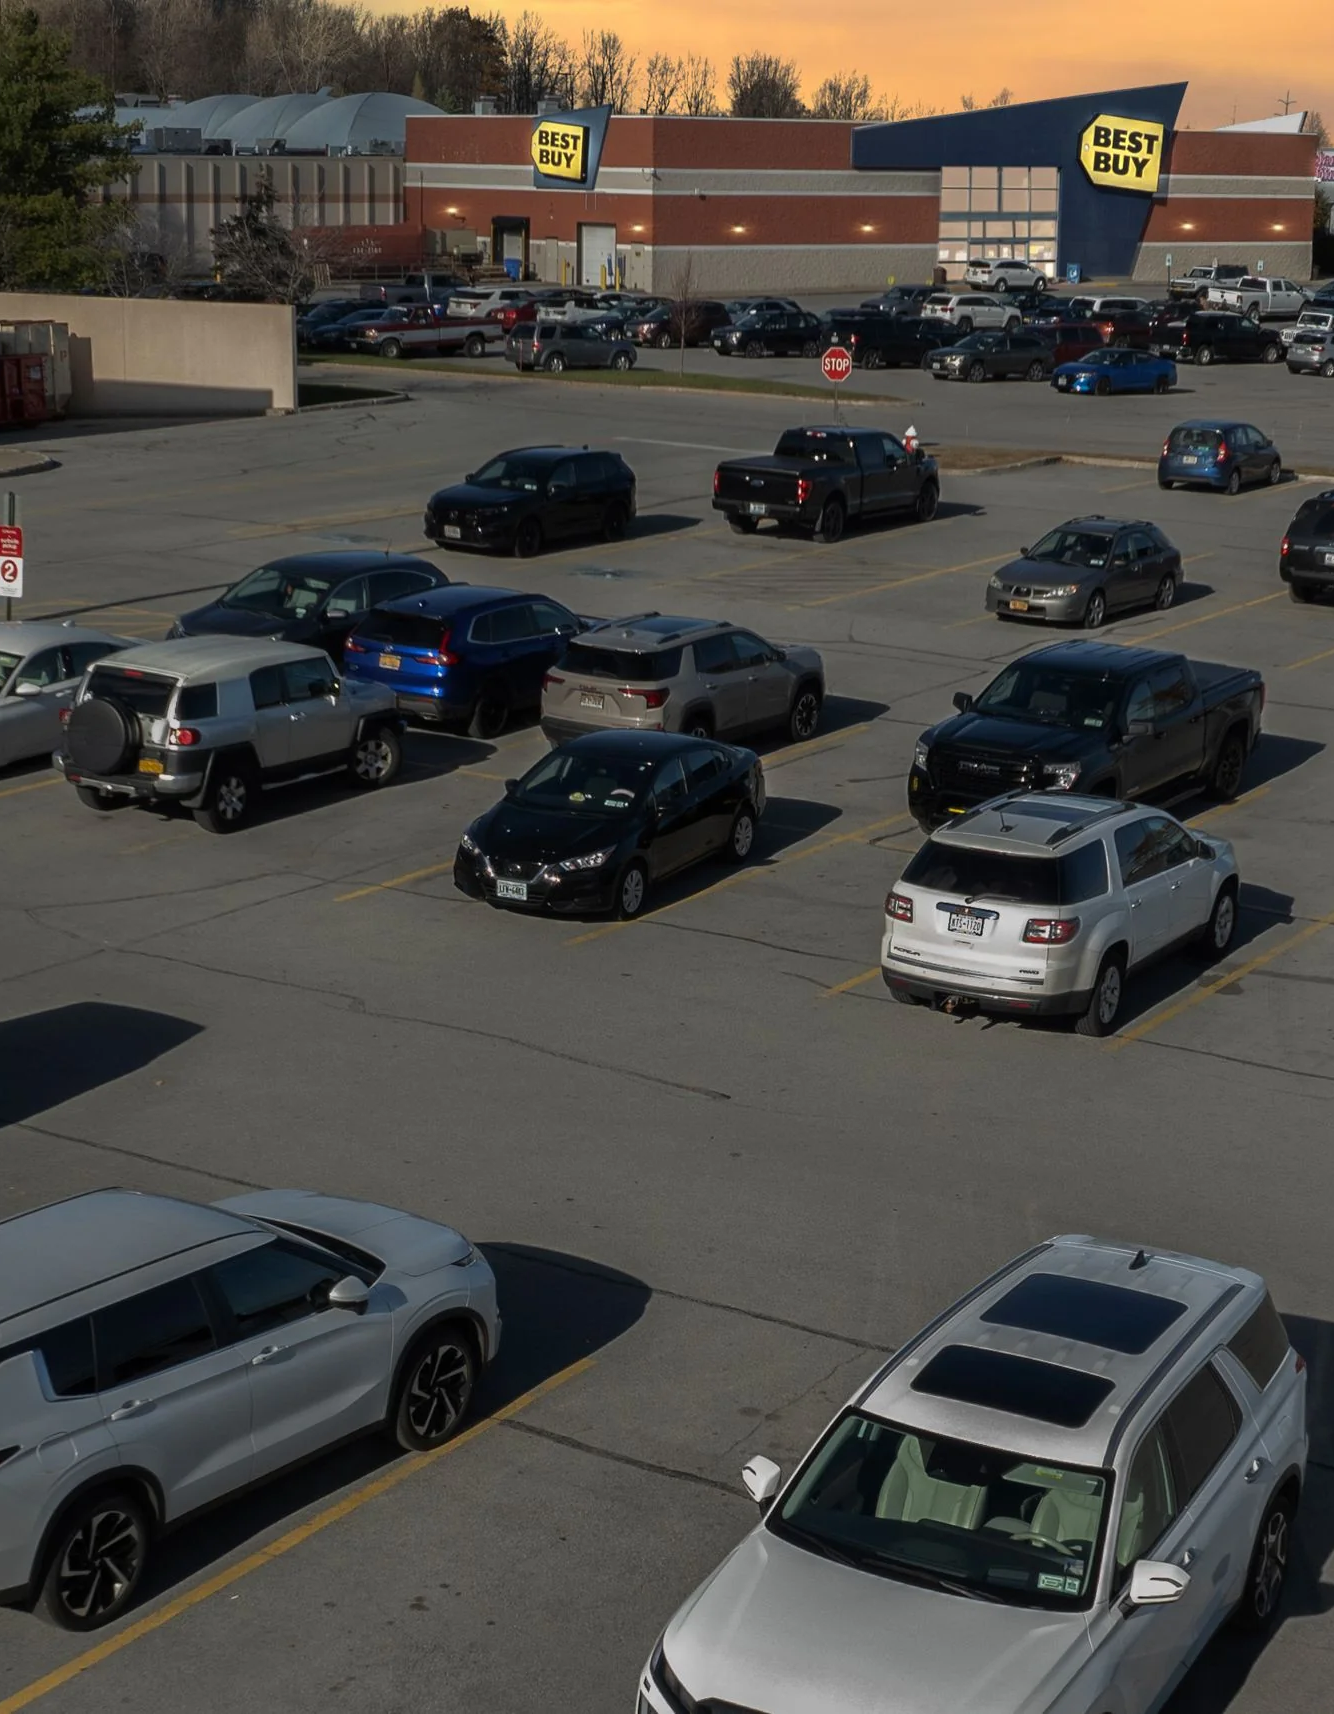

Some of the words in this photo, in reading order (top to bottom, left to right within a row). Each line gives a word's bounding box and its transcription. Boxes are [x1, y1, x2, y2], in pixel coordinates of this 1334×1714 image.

[538, 130, 580, 151] BEST
[1093, 125, 1159, 154] BEST
[539, 149, 575, 169] BUY
[1093, 151, 1151, 178] BUY
[824, 358, 849, 371] STOP
[4, 562, 14, 580] 2
